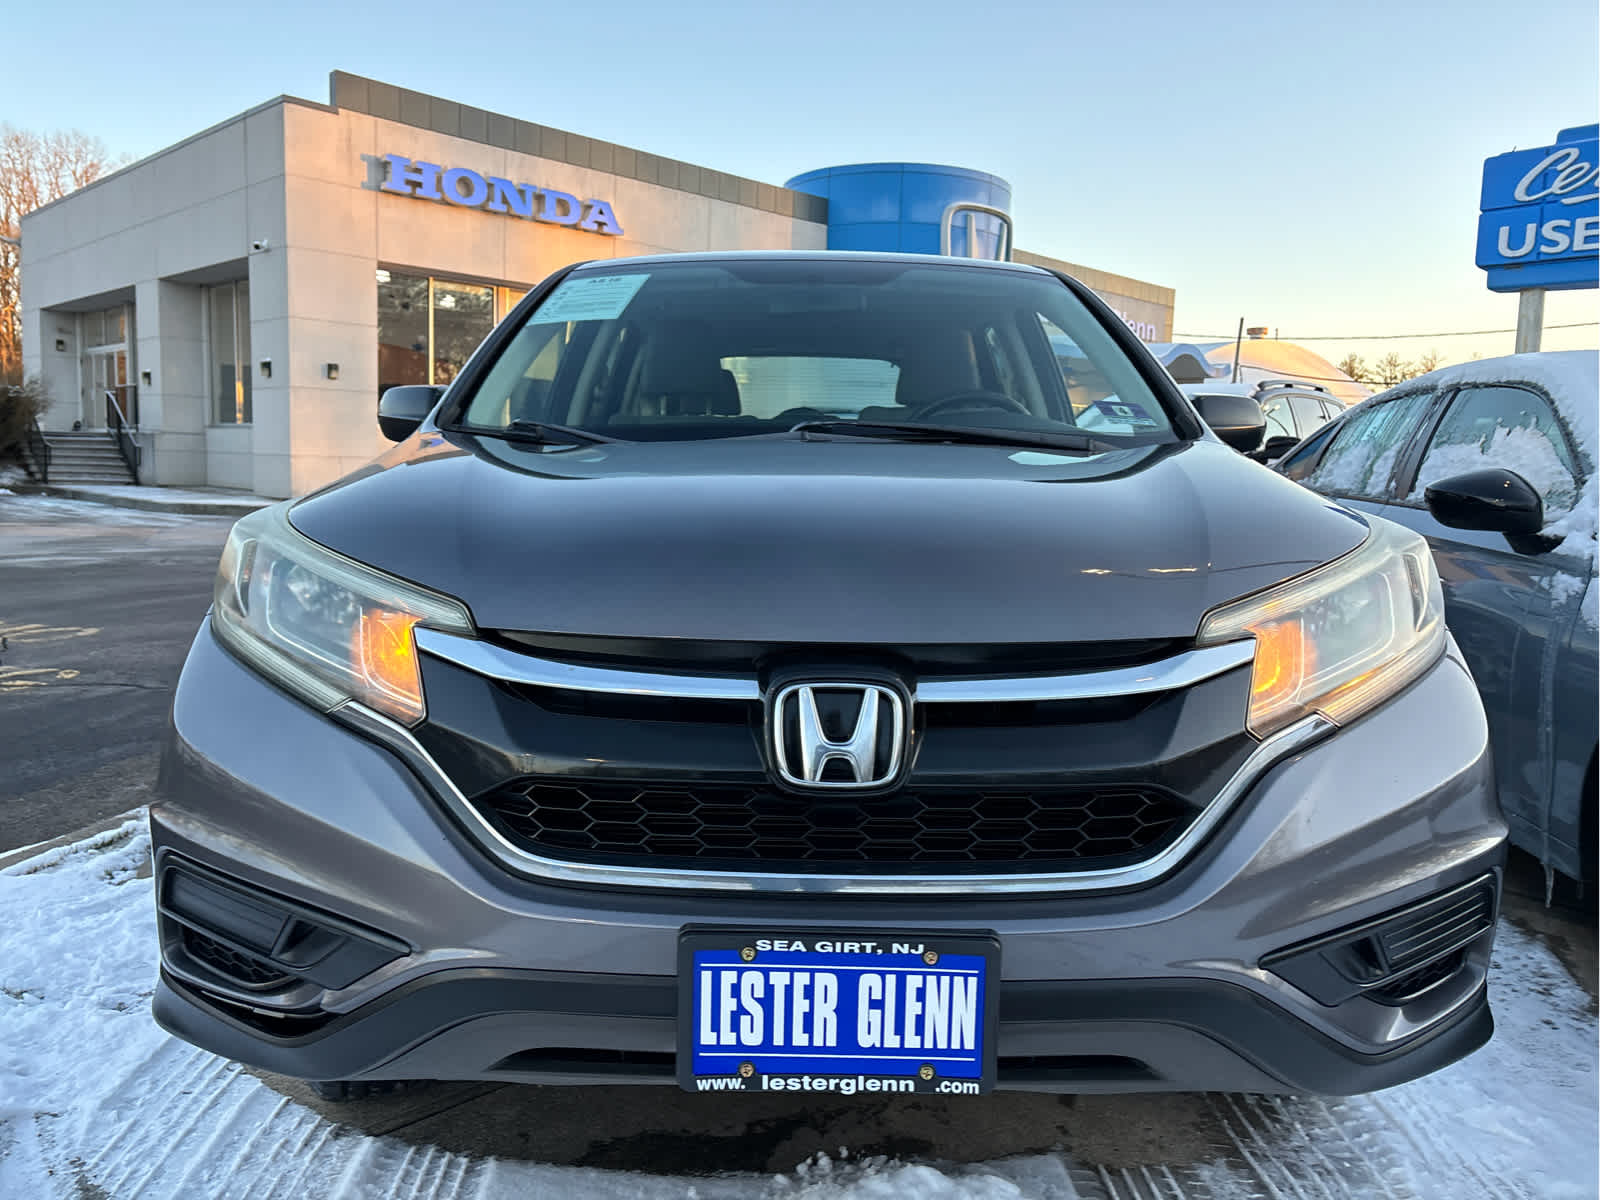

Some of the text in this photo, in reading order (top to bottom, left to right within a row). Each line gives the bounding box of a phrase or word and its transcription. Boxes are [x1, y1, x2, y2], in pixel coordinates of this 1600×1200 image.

[384, 153, 625, 236] HONDA
[1514, 147, 1599, 202] Ce
[1498, 216, 1599, 258] USE
[755, 939, 925, 955] SEA GIRT, NJ
[700, 970, 979, 1050] LESTER GLENN
[696, 1075, 980, 1095] www. lesterglenn .com
